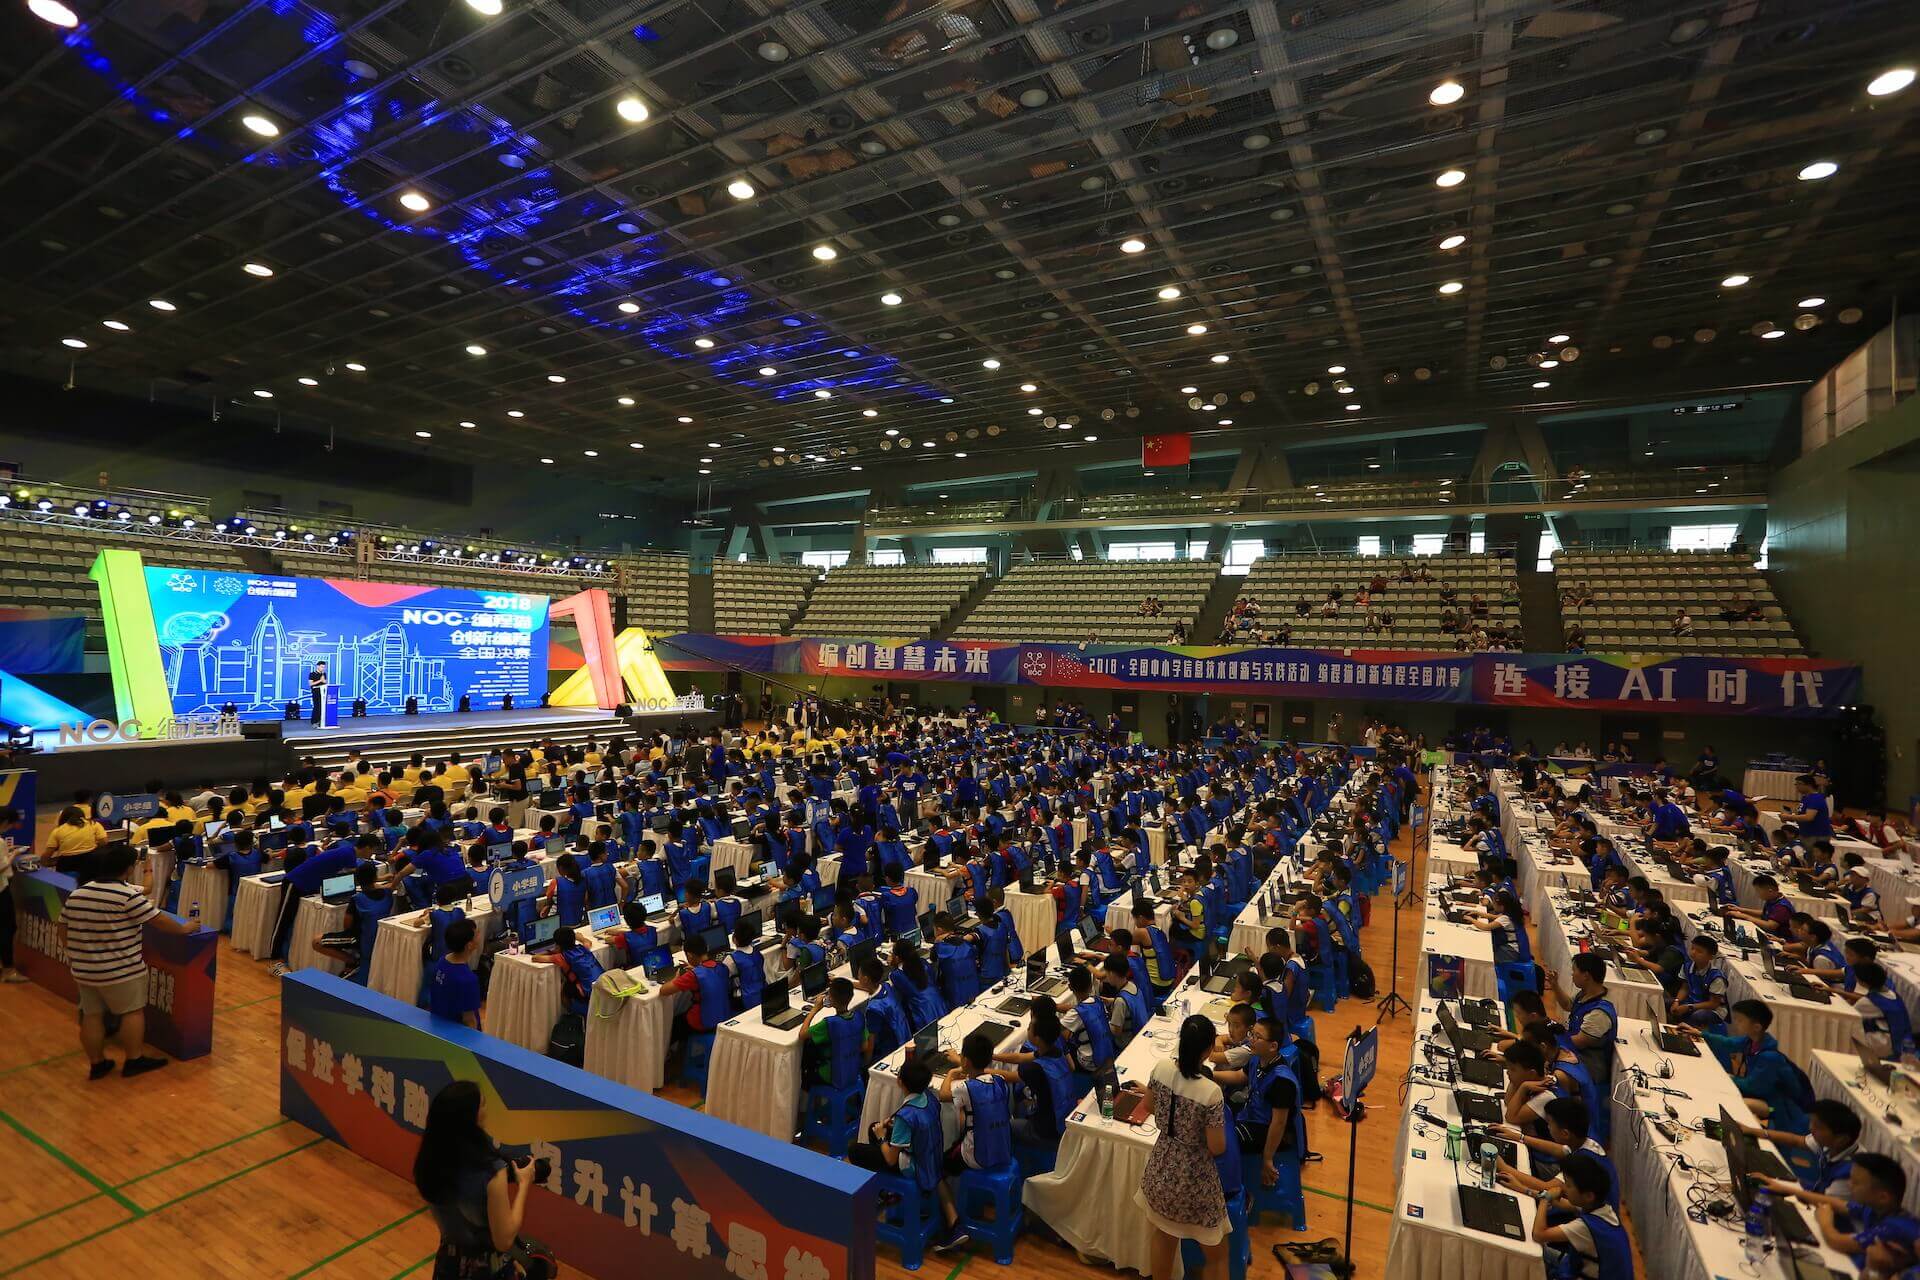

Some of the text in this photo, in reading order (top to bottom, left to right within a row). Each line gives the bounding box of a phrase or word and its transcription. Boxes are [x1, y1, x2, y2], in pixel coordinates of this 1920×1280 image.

[484, 595, 531, 610] 2018
[459, 647, 531, 659] 全国决赛
[818, 643, 989, 674] 编创智慧未来
[102, 802, 110, 811] A
